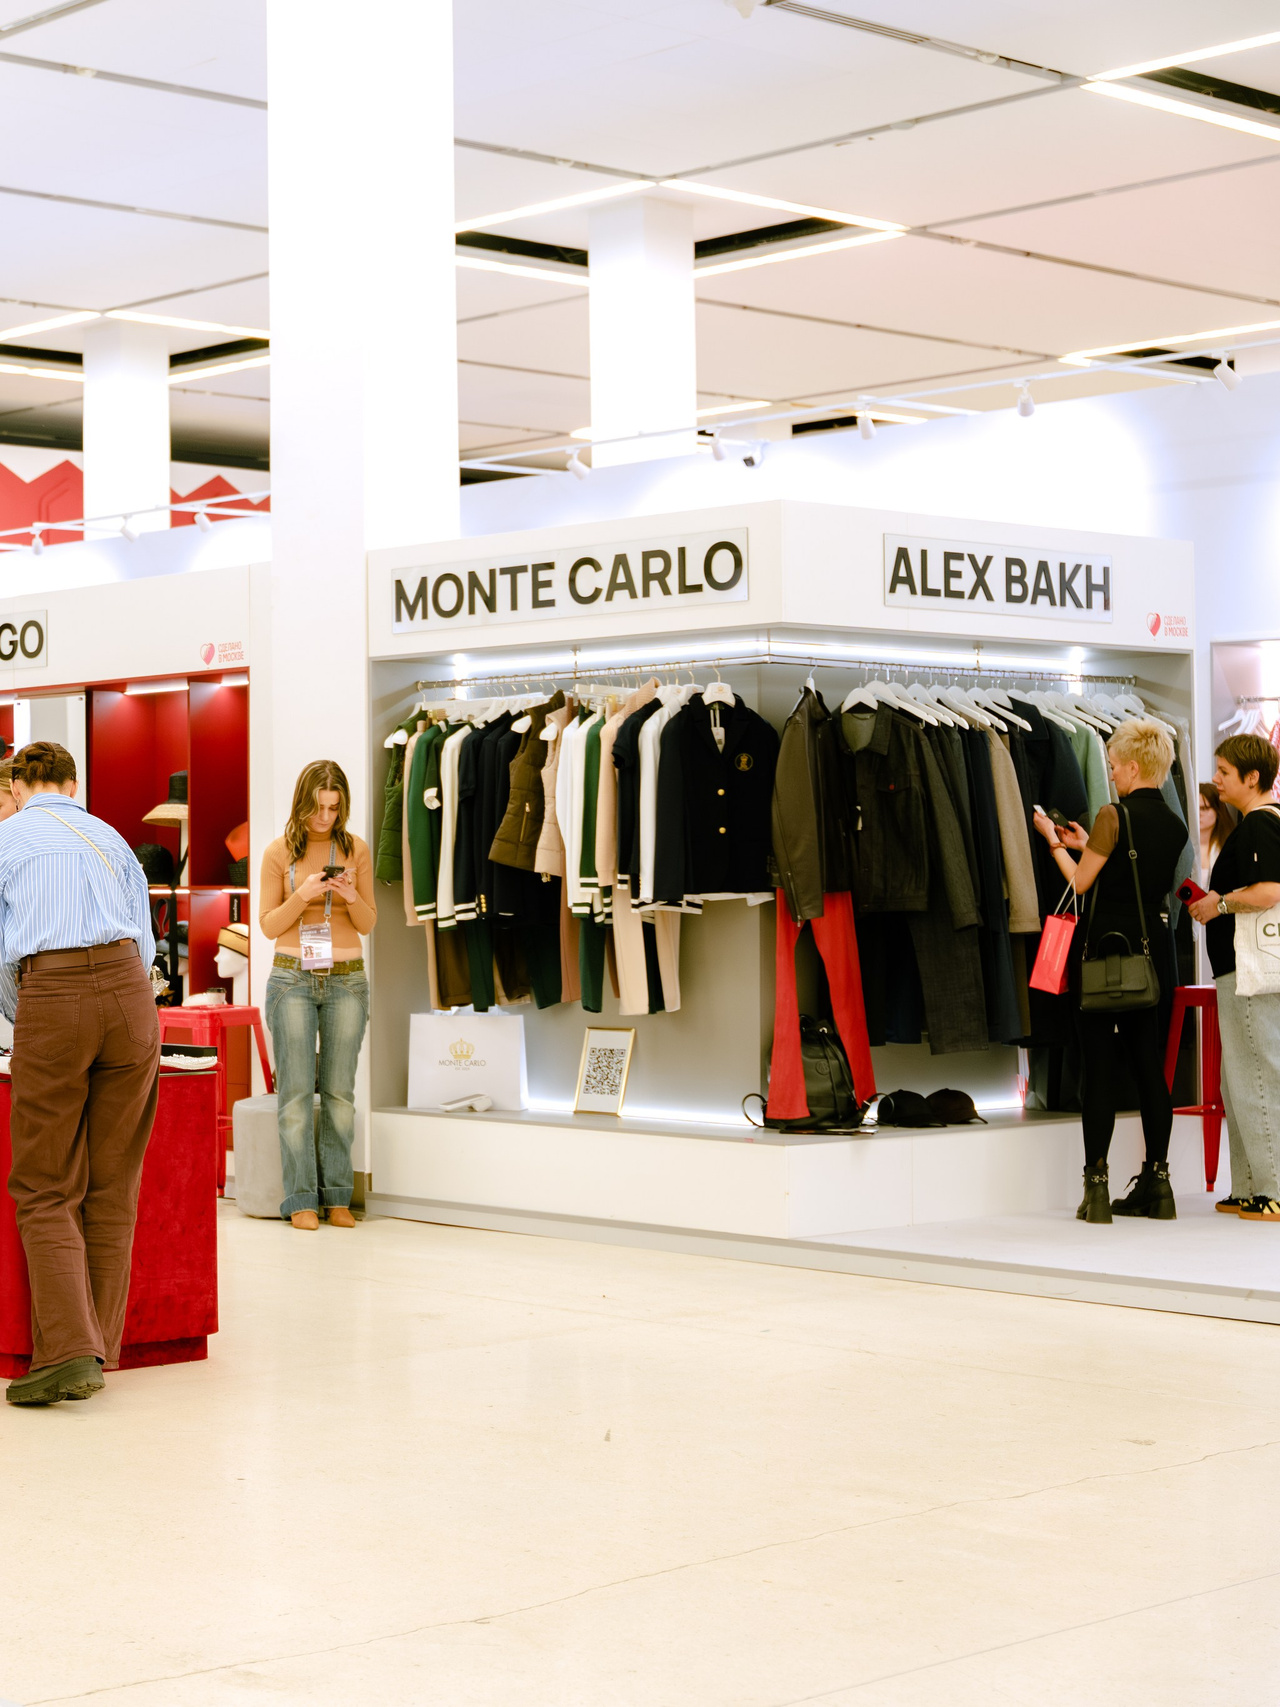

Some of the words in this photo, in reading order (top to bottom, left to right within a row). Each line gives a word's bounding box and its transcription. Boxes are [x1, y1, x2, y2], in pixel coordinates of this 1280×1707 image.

[394, 561, 557, 624] MONTE
[568, 541, 744, 605] CARLO
[888, 546, 995, 602] ALEX
[1005, 556, 1111, 611] BAKH
[438, 1059, 462, 1067] MONTE
[463, 1059, 487, 1067] CARLO
